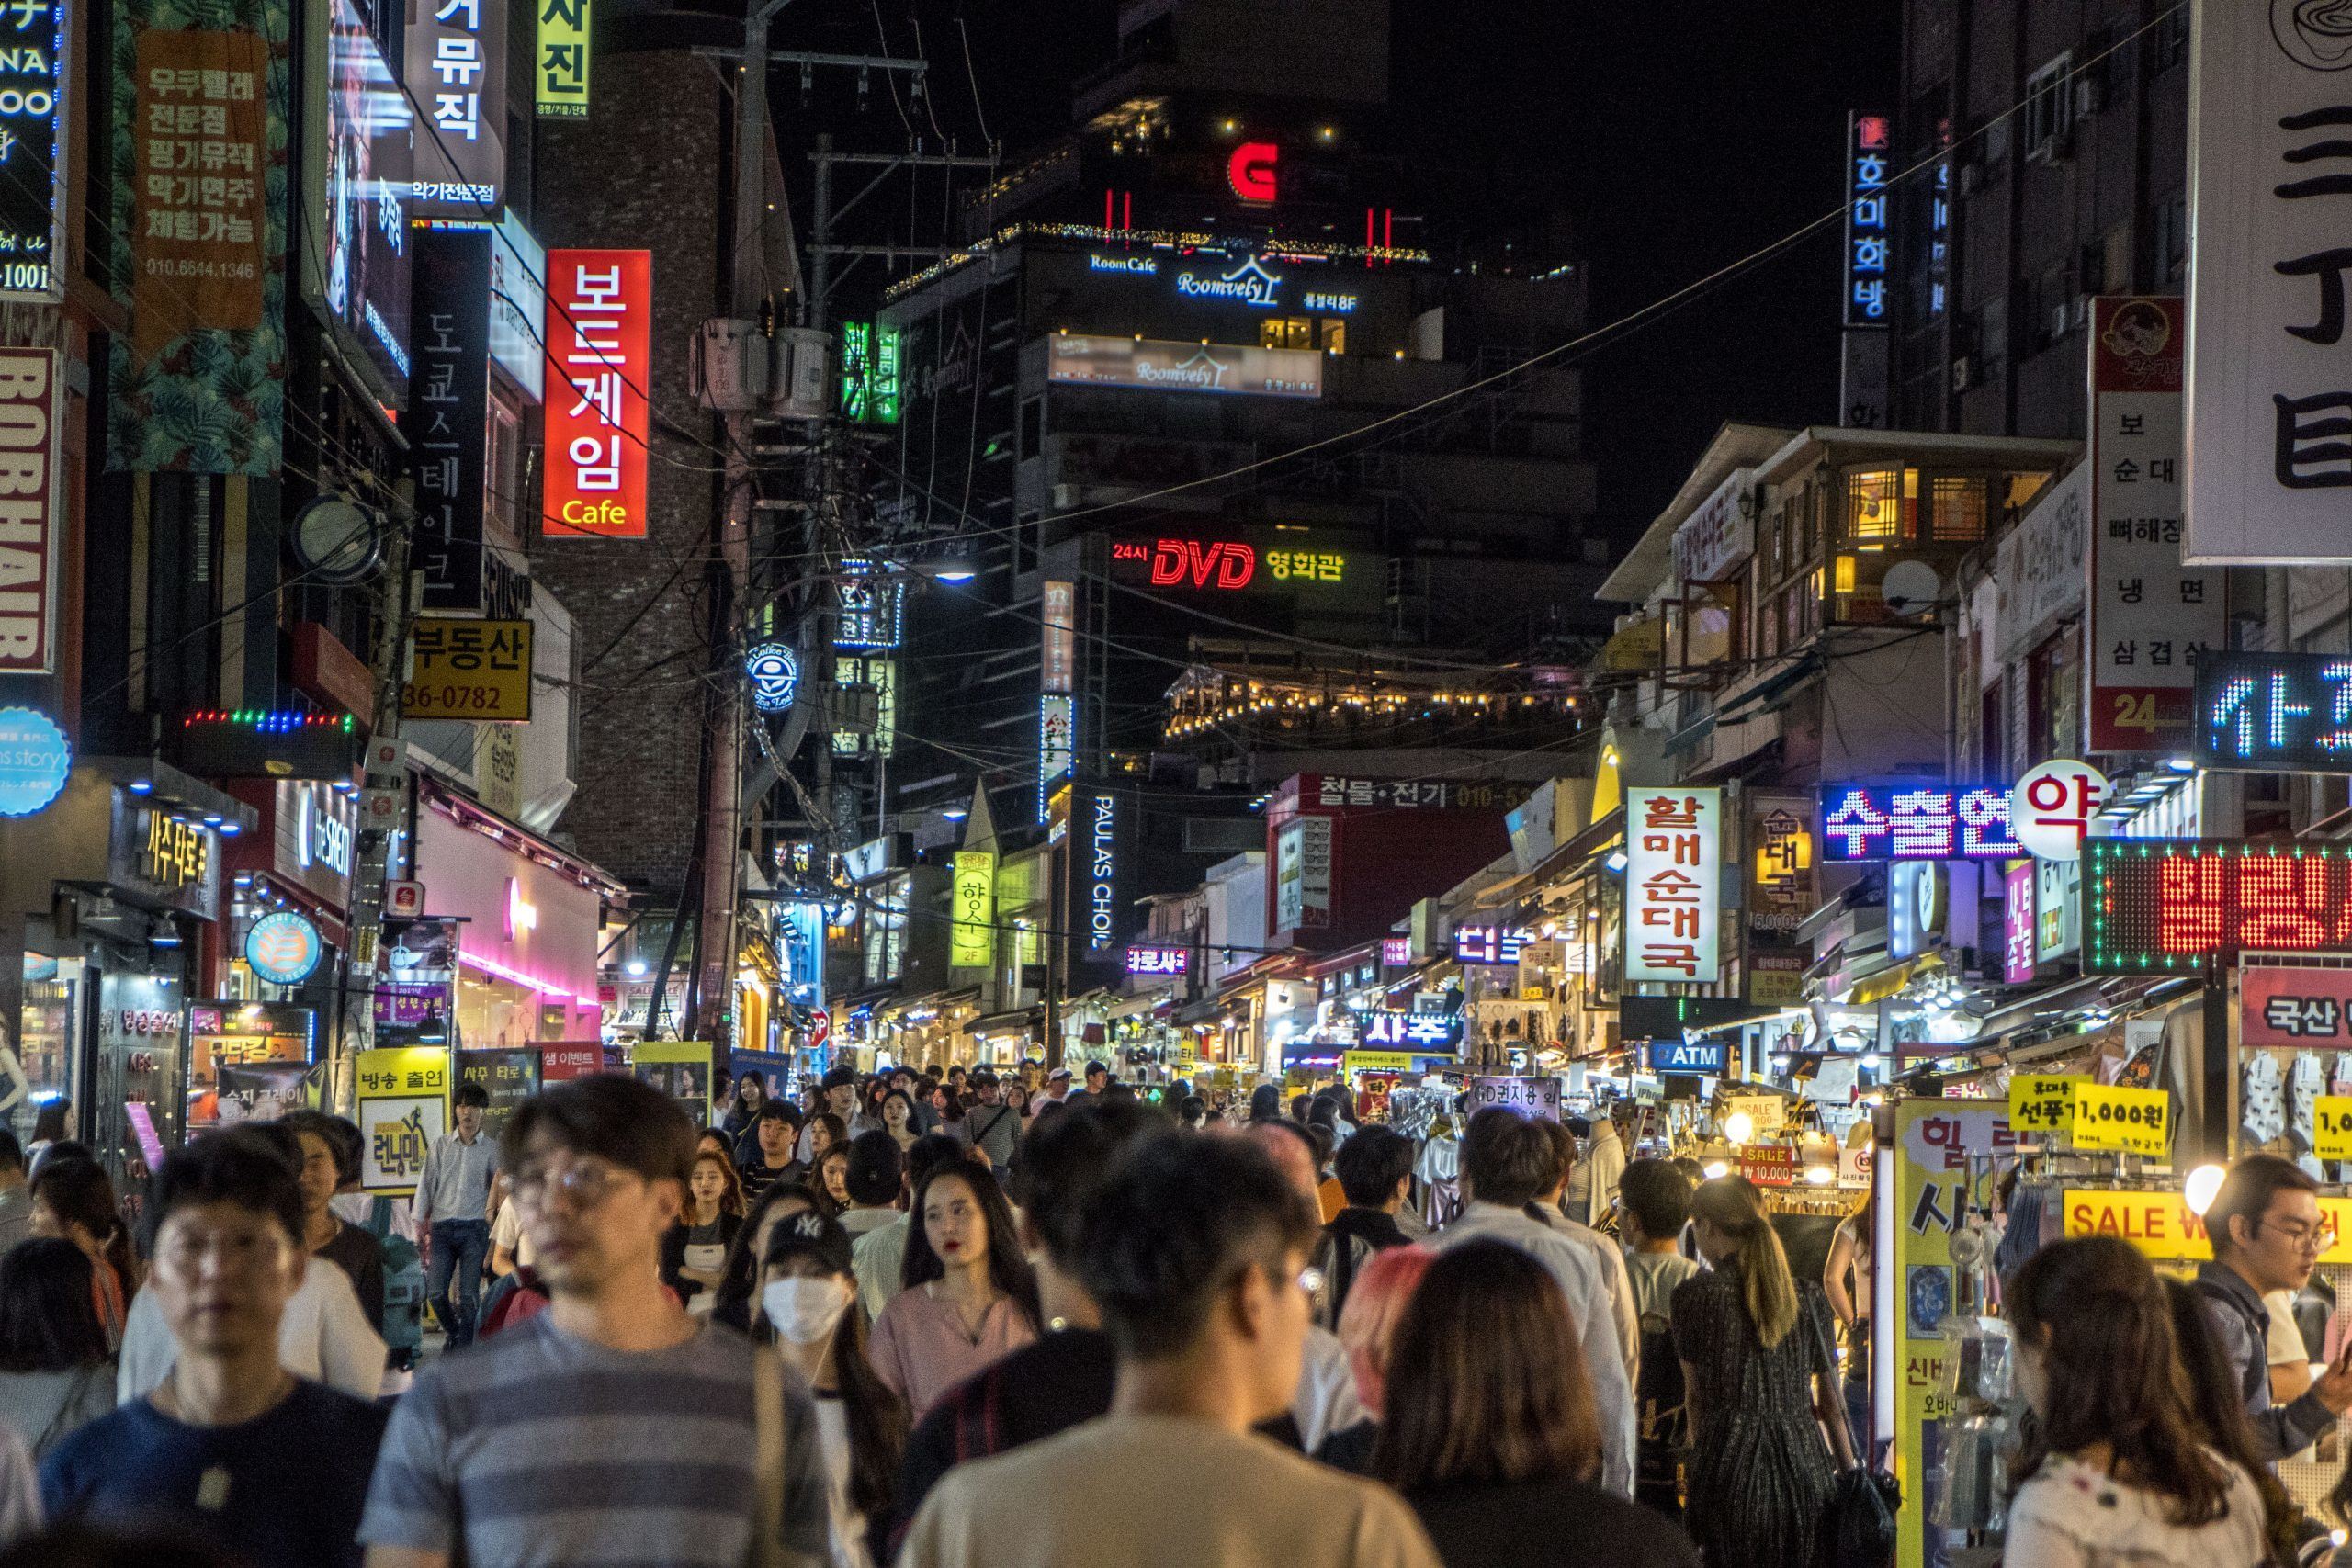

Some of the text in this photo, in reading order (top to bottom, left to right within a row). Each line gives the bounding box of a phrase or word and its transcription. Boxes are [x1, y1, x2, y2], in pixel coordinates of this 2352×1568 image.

[540, 0, 584, 94] 사진
[149, 104, 226, 135] 전문점
[147, 175, 254, 207] 악기연주
[412, 181, 494, 202] 악기전문점
[146, 209, 253, 242] 체험가능
[1090, 254, 1157, 273] Room Cafe
[1177, 270, 1263, 302] Roomvely
[567, 265, 627, 491] 보드게임
[421, 312, 463, 589] 도쿄스테이크
[561, 499, 628, 525] Cafe
[1113, 544, 1148, 562] 24시
[1151, 539, 1255, 589] DVD
[1266, 551, 1345, 581] 영화관
[414, 627, 524, 671] 부동산
[2027, 773, 2103, 854] 약
[1094, 795, 1114, 878] PAULA'S
[1640, 795, 1704, 976] 할매순대국
[964, 951, 978, 962] 2F
[1386, 942, 1408, 952] 사주
[1366, 1014, 1449, 1043] 사주
[2266, 997, 2340, 1037] 국산
[559, 1052, 594, 1066] 이벤트
[1671, 1047, 1718, 1065] ATM
[361, 1069, 443, 1091] 방송 출연
[2080, 1100, 2164, 1130] 1,000원
[1747, 1149, 1787, 1162] SALE
[1755, 1166, 1790, 1181] 10,000
[2072, 1202, 2166, 1240] SALE
